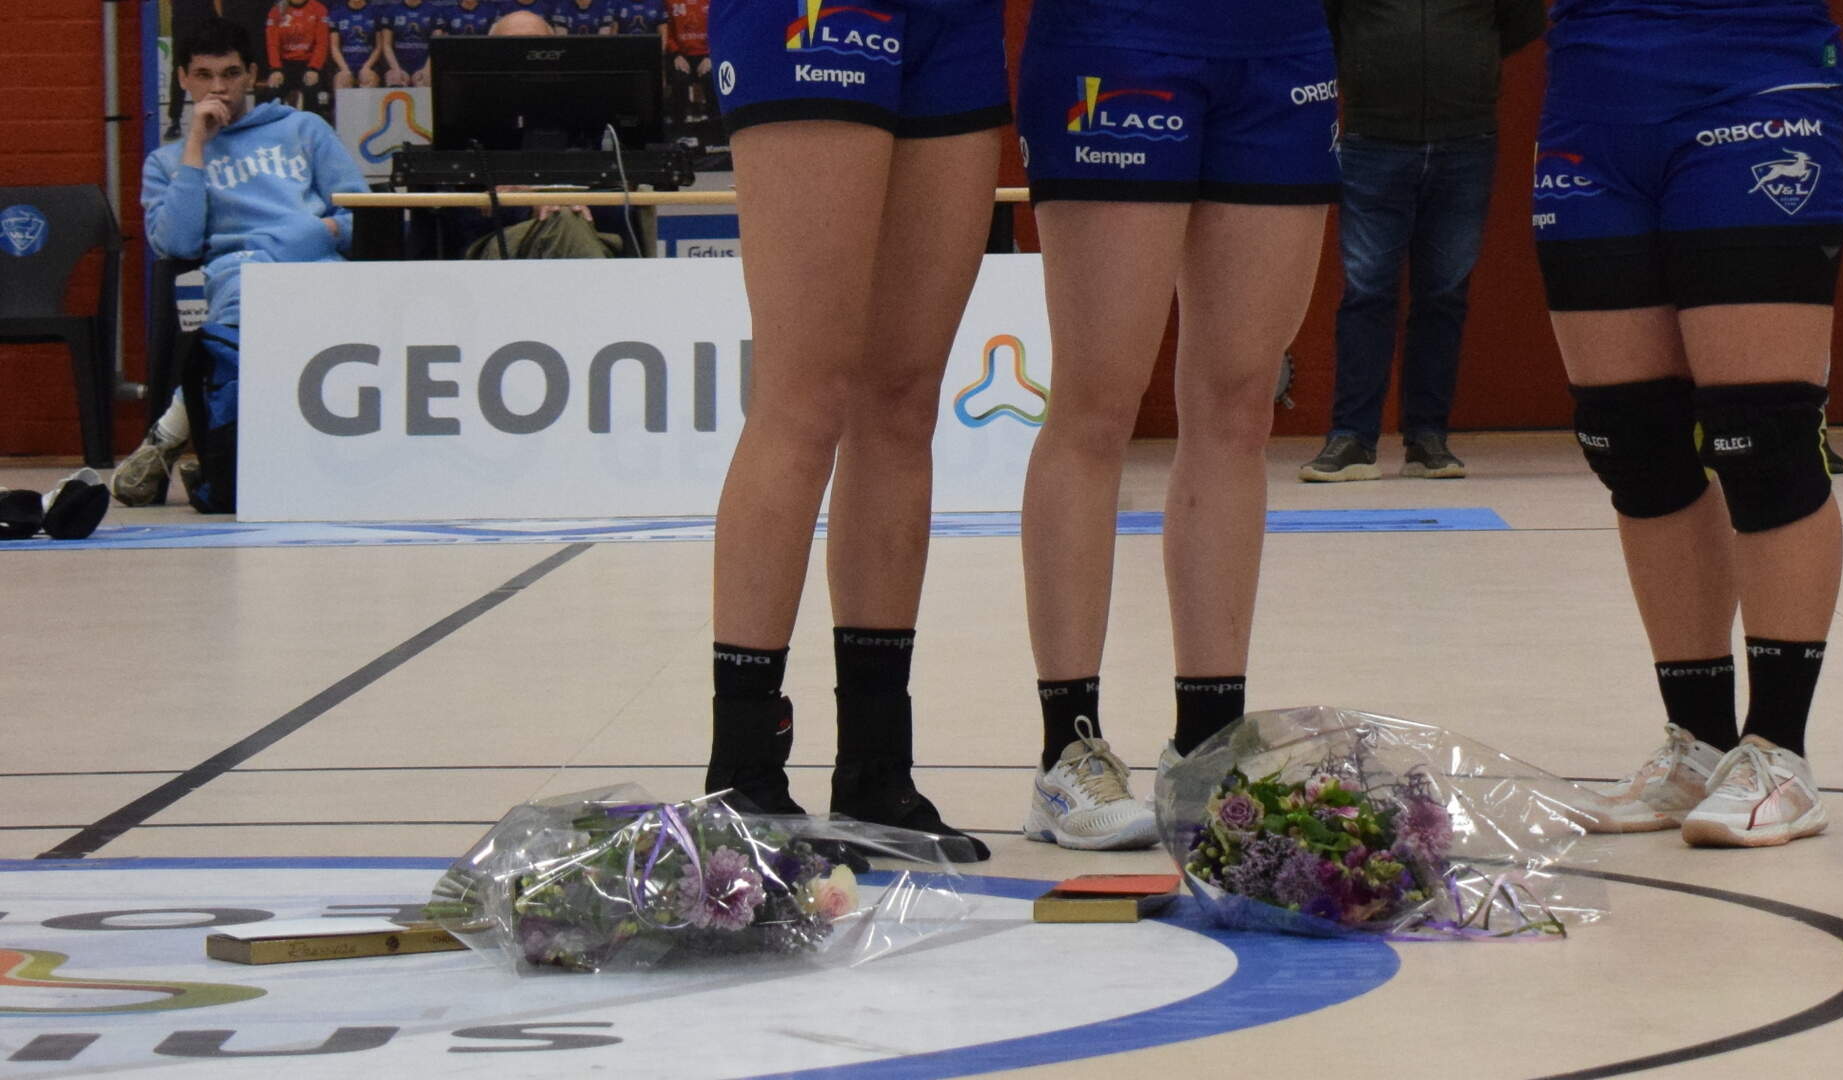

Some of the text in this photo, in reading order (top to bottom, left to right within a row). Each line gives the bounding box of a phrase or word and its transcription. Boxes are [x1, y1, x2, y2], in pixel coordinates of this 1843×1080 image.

[822, 26, 901, 54] LACO
[795, 64, 865, 87] Kempa
[1101, 112, 1184, 131] LACO
[1696, 118, 1823, 147] ORBCOMM
[1075, 146, 1146, 168] Kempa
[1767, 183, 1808, 196] V&L
[297, 339, 753, 437] GEONI
[1578, 432, 1611, 448] SELECT
[1175, 681, 1245, 695] Kempa
